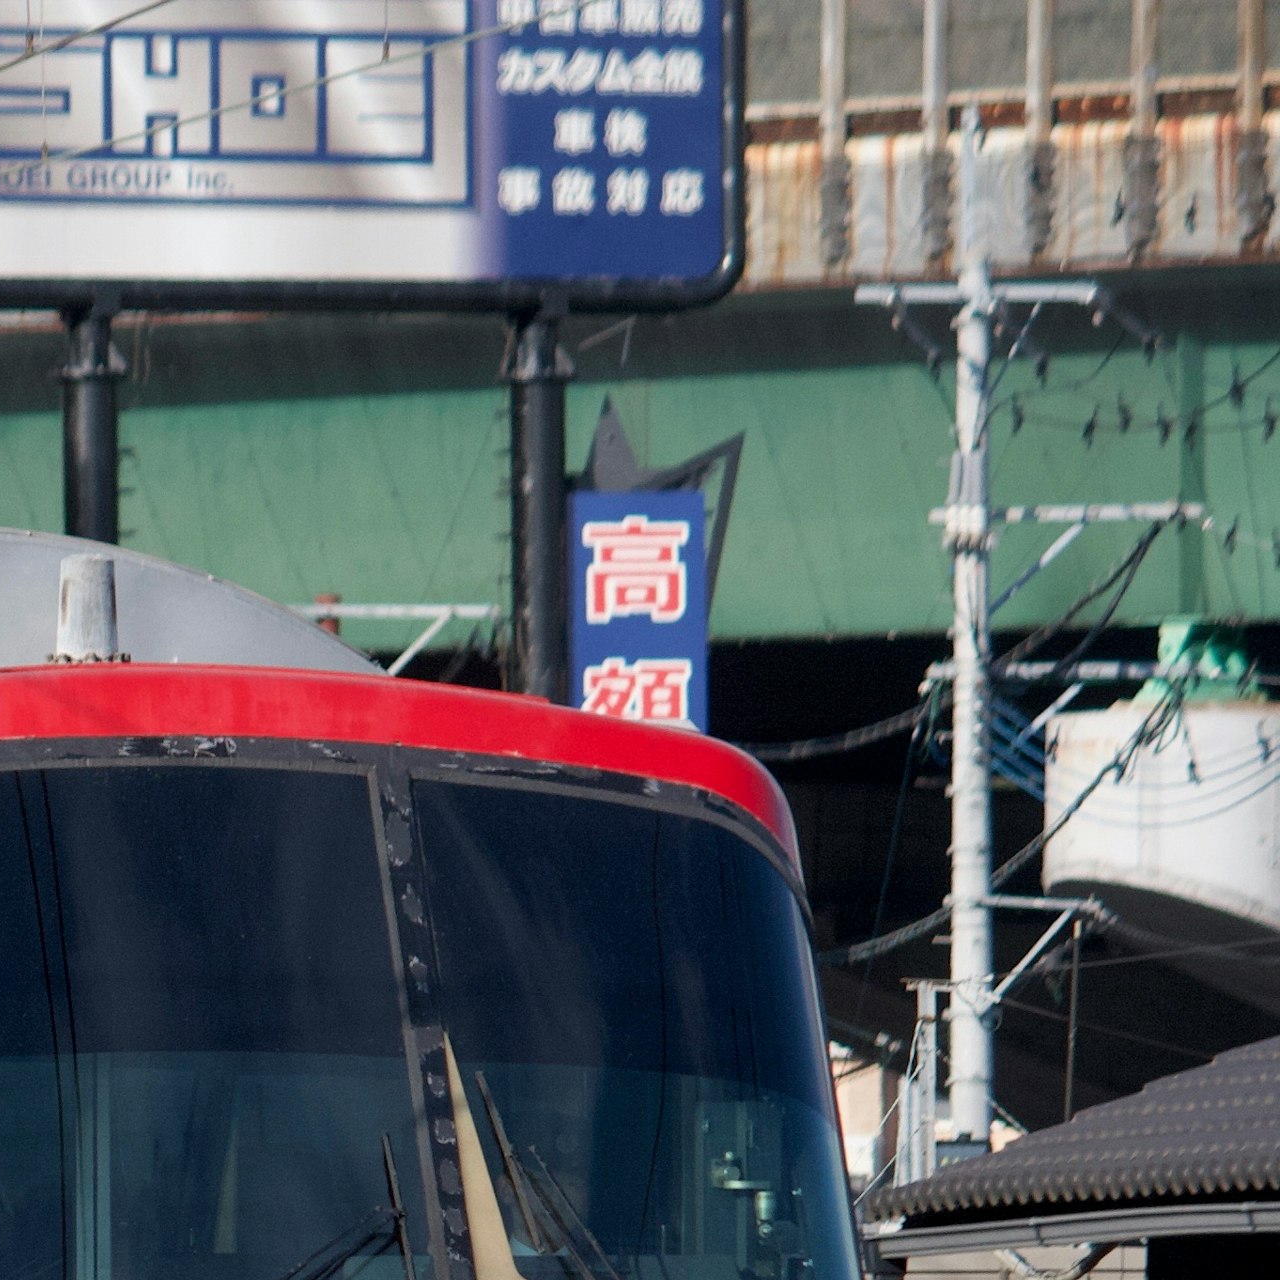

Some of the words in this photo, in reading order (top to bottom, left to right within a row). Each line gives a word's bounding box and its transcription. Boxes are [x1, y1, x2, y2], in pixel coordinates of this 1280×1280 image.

[496, 46, 704, 97] カスタム全般
[553, 107, 648, 157] 車検
[67, 165, 172, 190] GROUP
[497, 166, 704, 216] 事故対応
